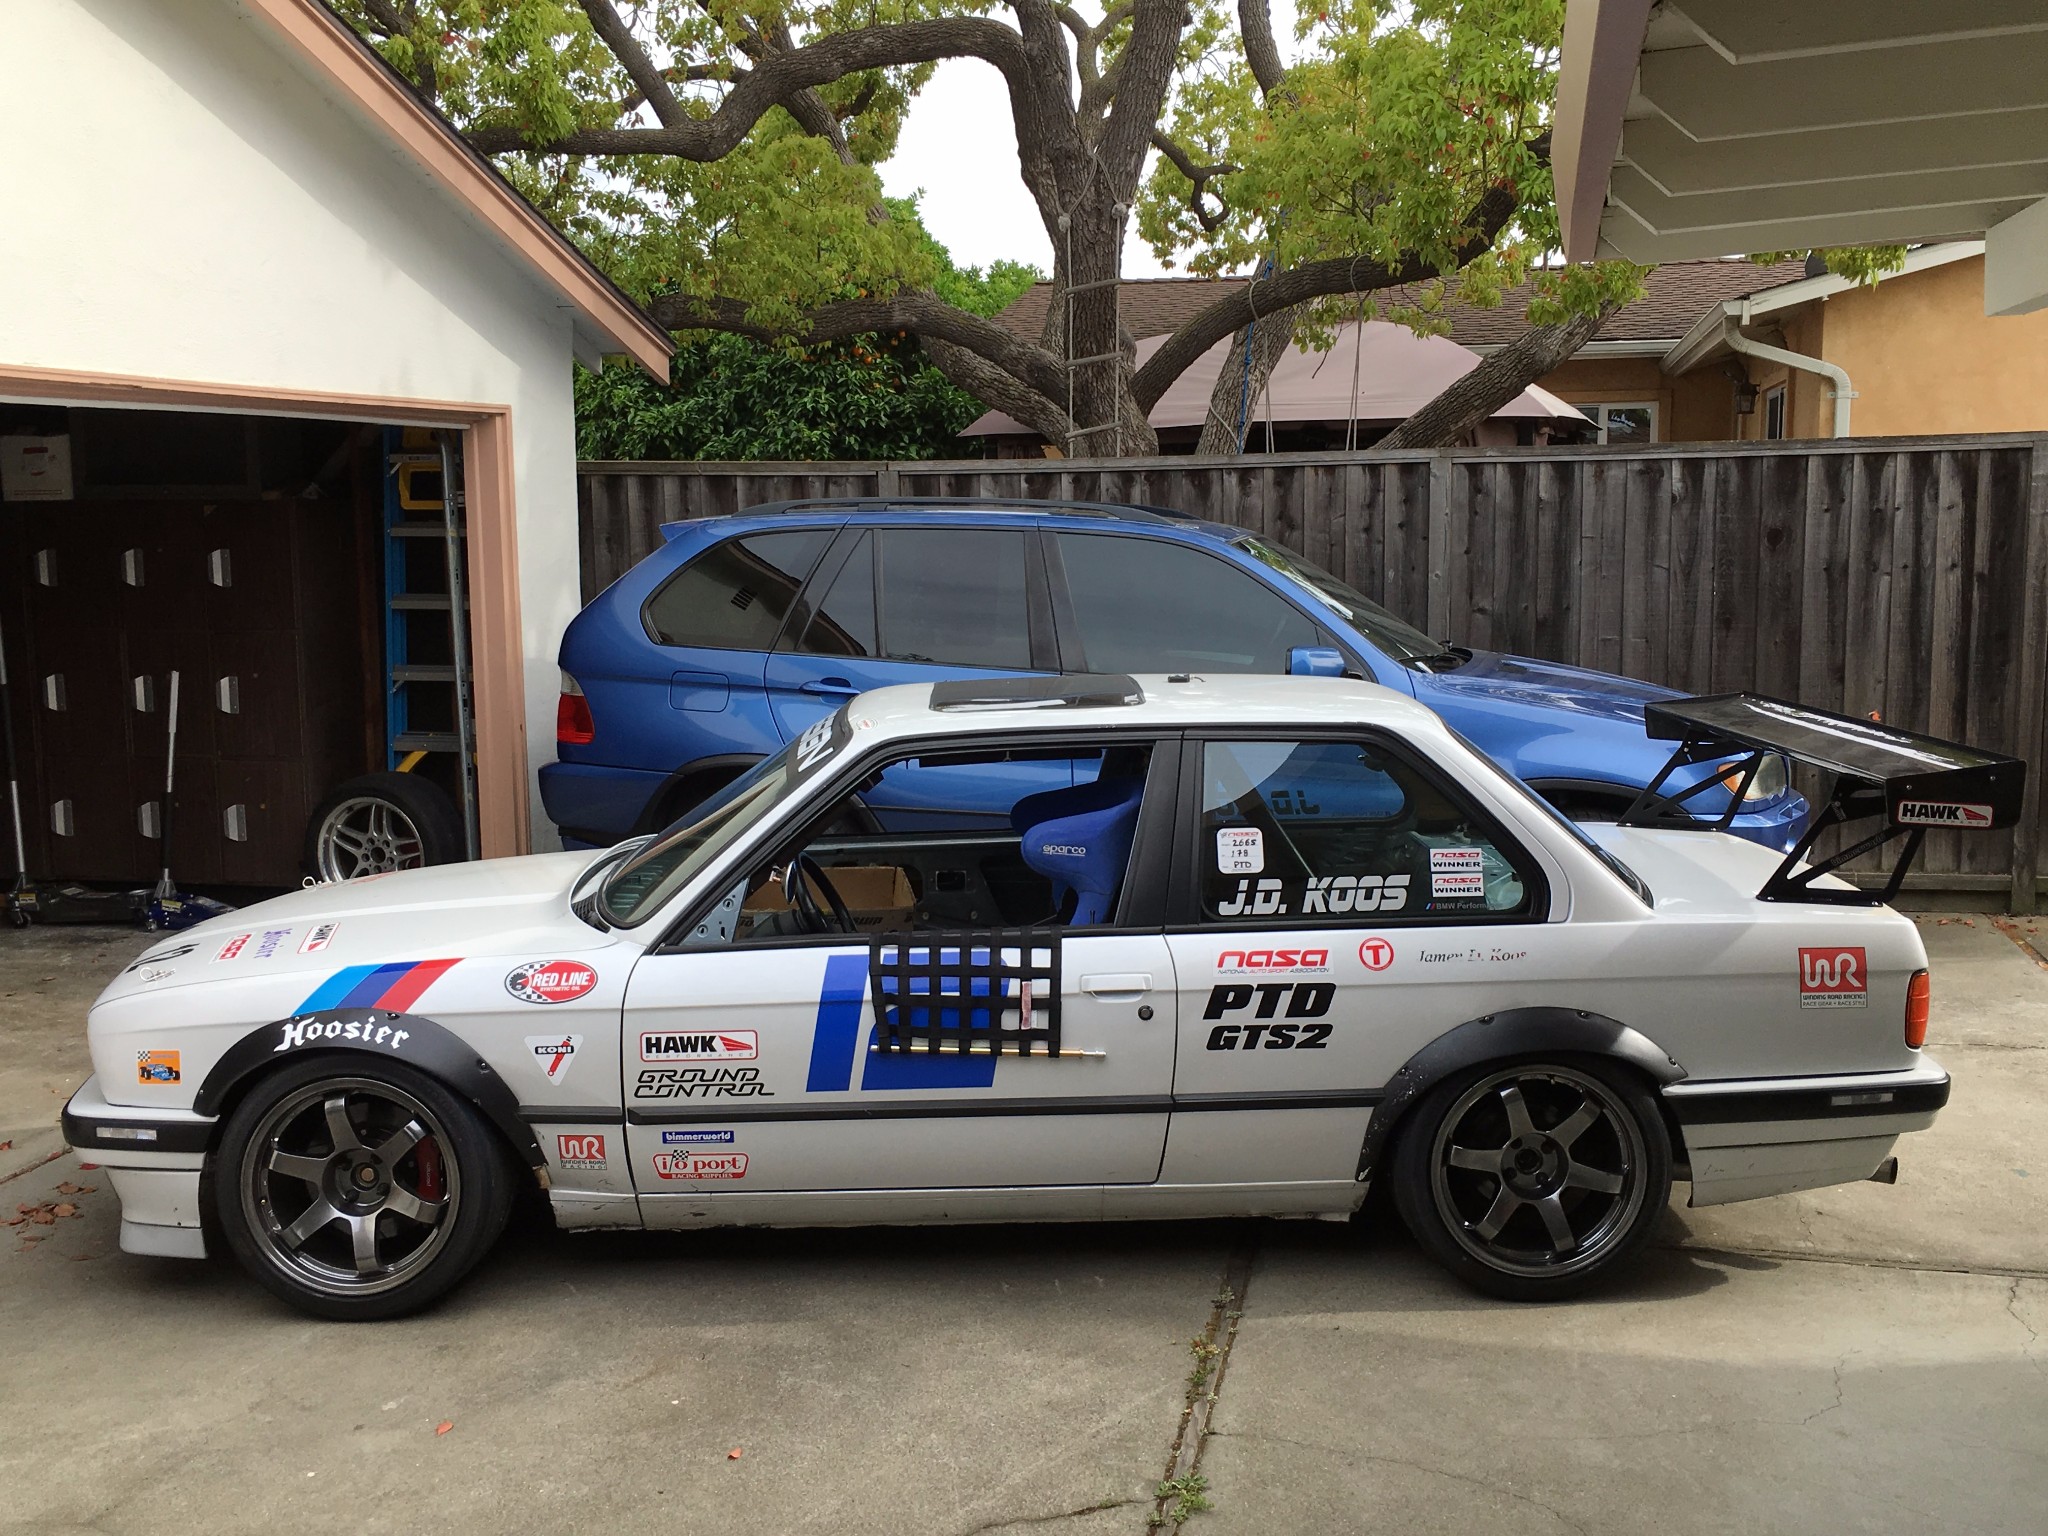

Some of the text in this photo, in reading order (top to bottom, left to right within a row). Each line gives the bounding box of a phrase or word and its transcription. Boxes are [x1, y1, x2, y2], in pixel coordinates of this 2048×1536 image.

[1902, 803, 1961, 819] HAWK
[1043, 844, 1086, 856] sparco
[1231, 849, 1249, 857] 178
[1218, 874, 1411, 915] J.D. KOOS
[1217, 949, 1329, 968] nasa
[532, 971, 591, 987] RED LINE
[1203, 983, 1337, 1020] PTD
[273, 1015, 410, 1052] Hoosier
[1206, 1024, 1333, 1050] GTS2
[537, 1046, 572, 1054] KONI
[645, 1035, 717, 1053] HAWK
[638, 1068, 760, 1083] GROUND
[634, 1083, 775, 1098] CONTROL
[665, 1132, 731, 1141] bimmerworld
[693, 1157, 741, 1172] port
